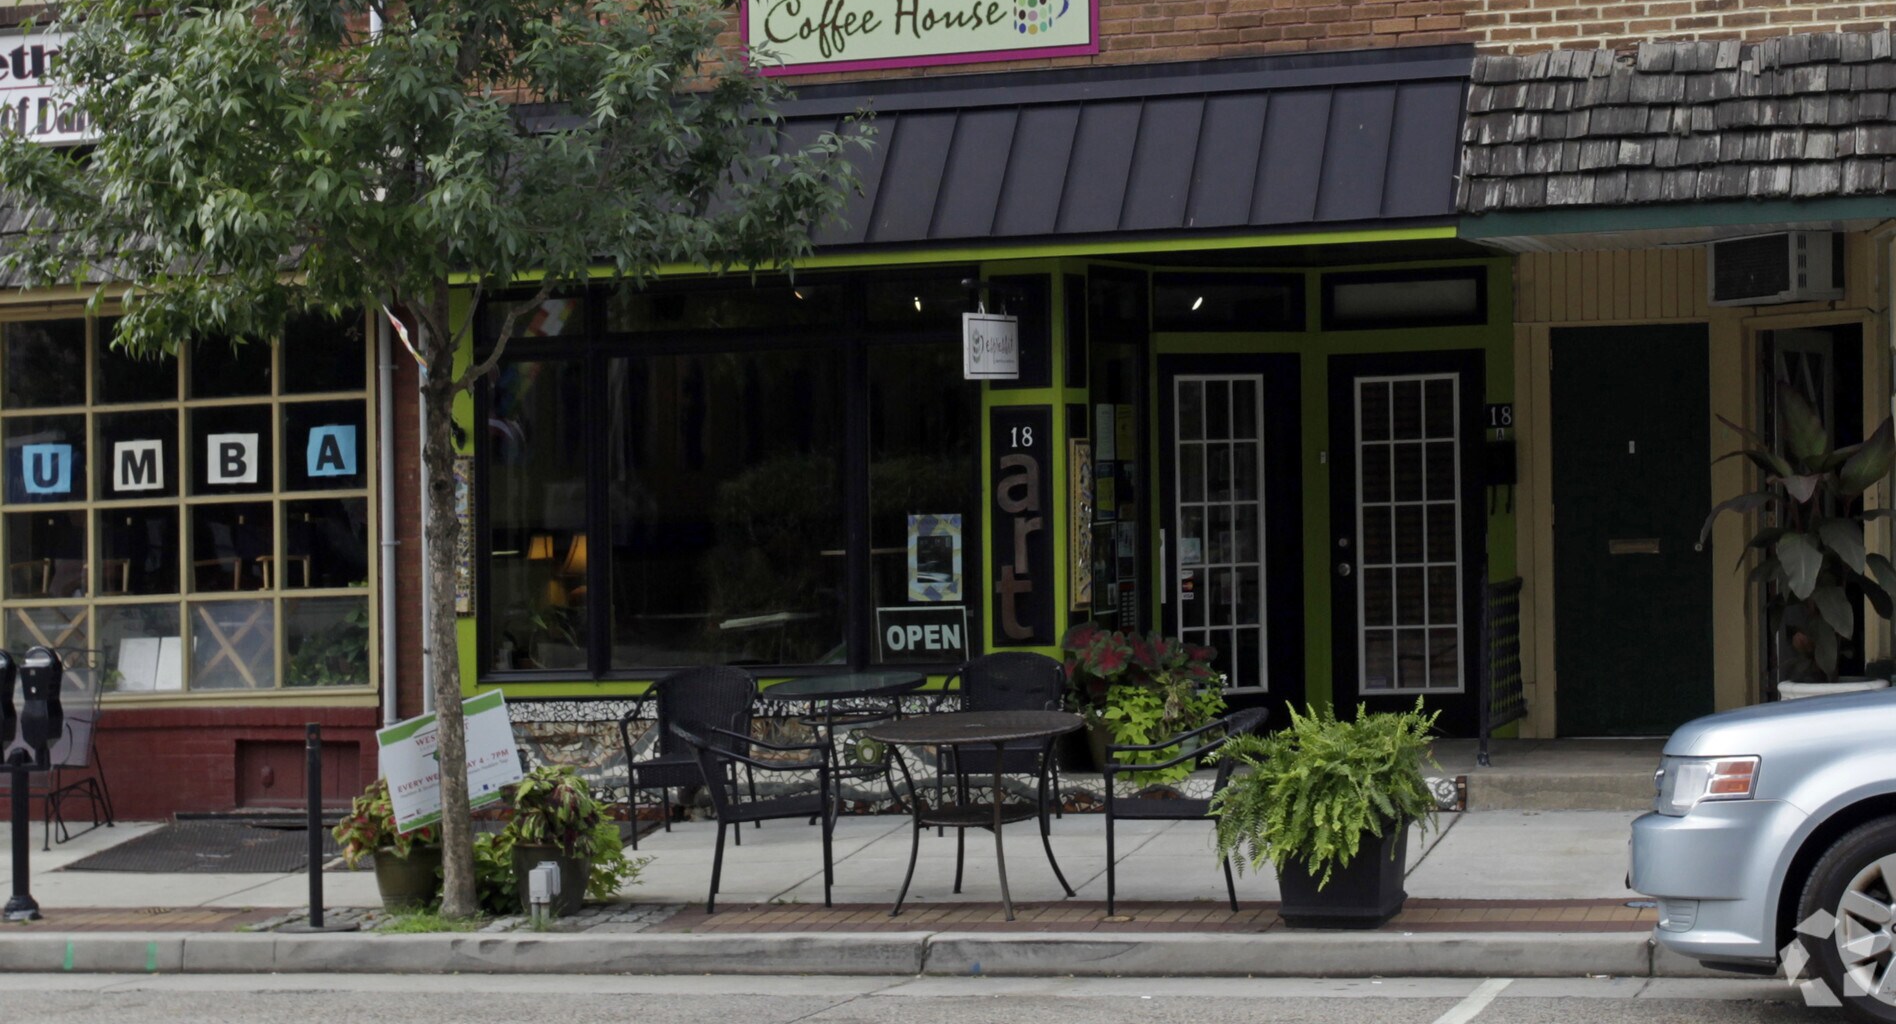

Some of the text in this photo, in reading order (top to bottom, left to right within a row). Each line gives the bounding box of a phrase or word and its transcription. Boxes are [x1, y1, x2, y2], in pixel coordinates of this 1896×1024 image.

[0, 96, 96, 135] of Dan
[1490, 405, 1512, 426] 18
[1010, 426, 1034, 448] 18
[996, 453, 1043, 640] art
[886, 624, 962, 651] OPEN
[397, 777, 424, 792] EVERY
[491, 748, 509, 760] 7PM
